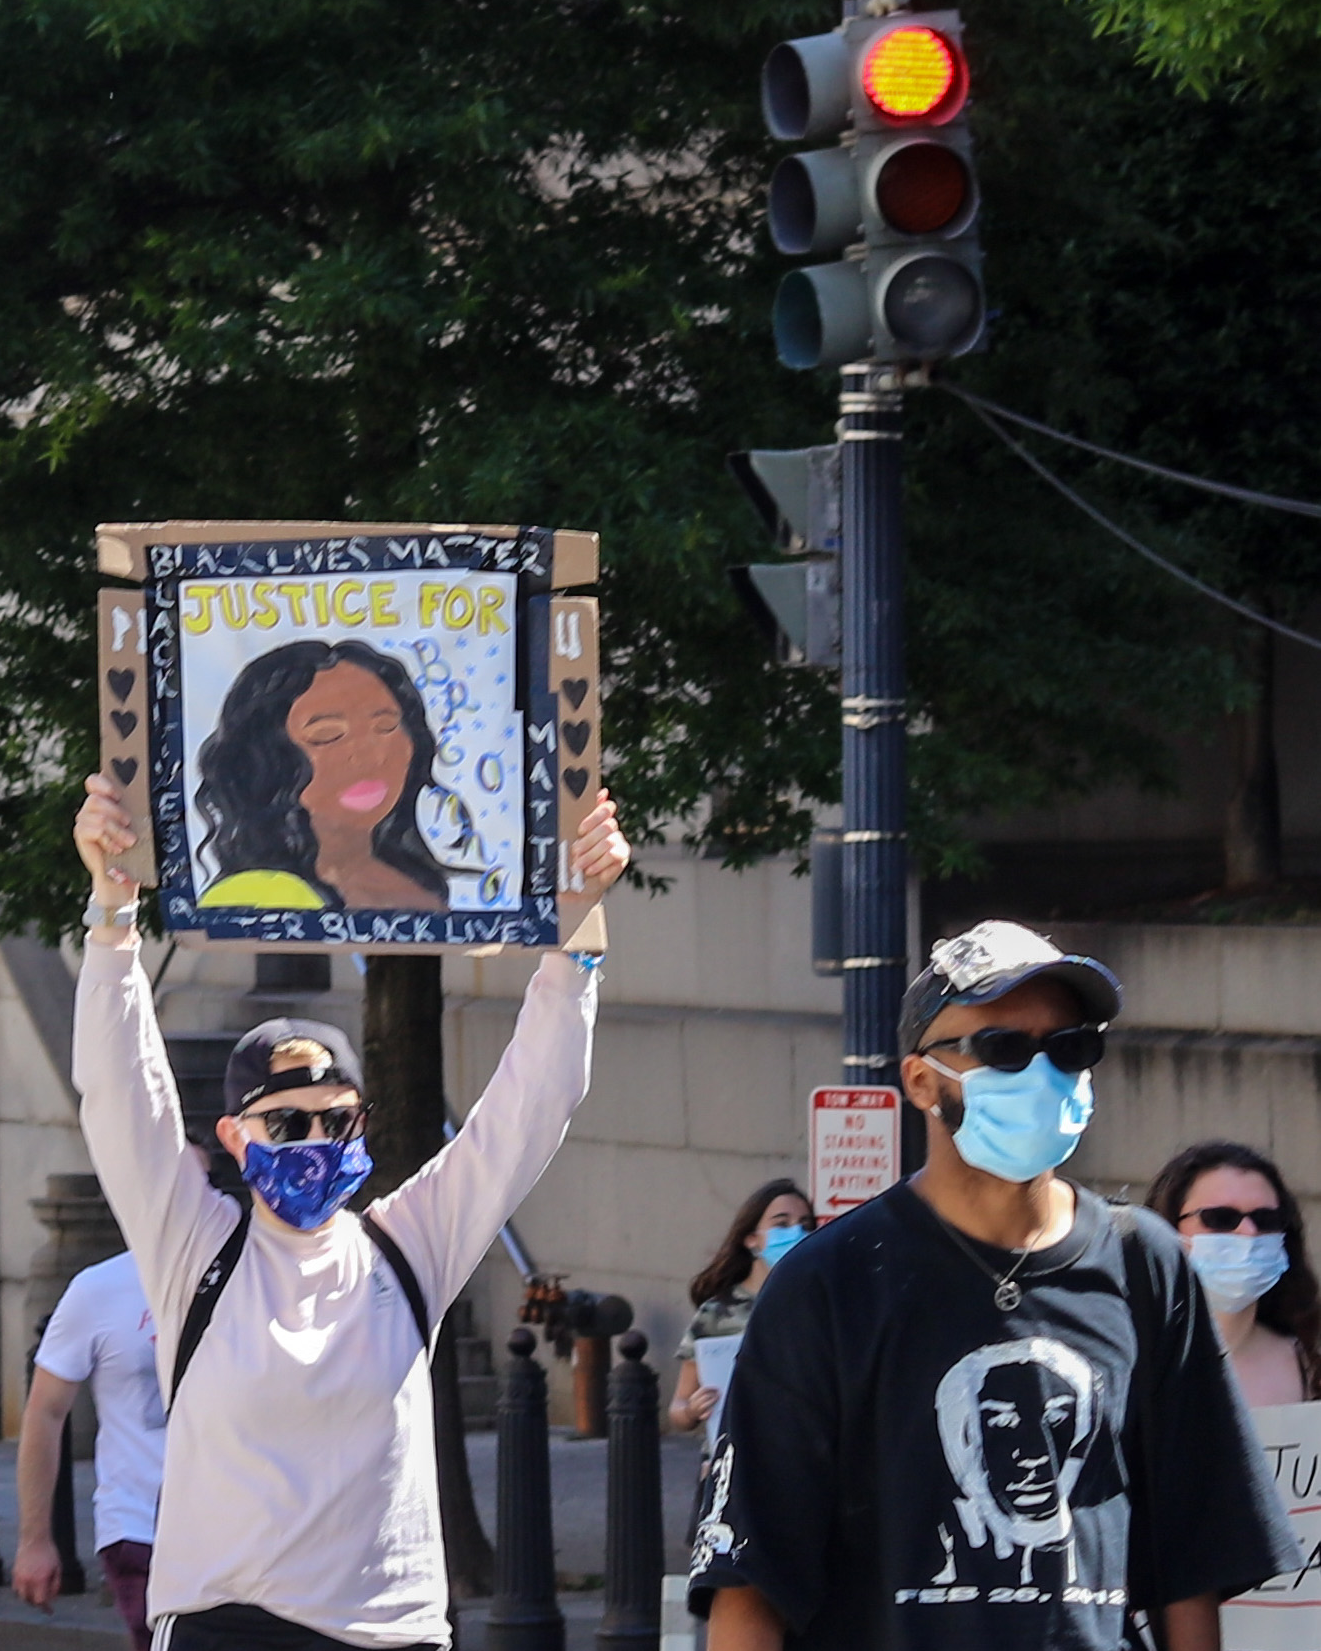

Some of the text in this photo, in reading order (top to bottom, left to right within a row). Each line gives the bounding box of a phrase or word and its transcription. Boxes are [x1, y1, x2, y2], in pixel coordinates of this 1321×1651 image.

[267, 535, 371, 574] LIVES
[183, 579, 400, 636] JUSTICE
[417, 580, 511, 636] FOR
[318, 911, 436, 945] BLACK
[445, 914, 541, 945] LIVES
[844, 1114, 866, 1131] NO
[824, 1134, 886, 1150] STANDING
[833, 1154, 890, 1170] PARKING
[829, 1174, 882, 1190] ANYTIME
[894, 1585, 1128, 1605] FEB 26, 2012
